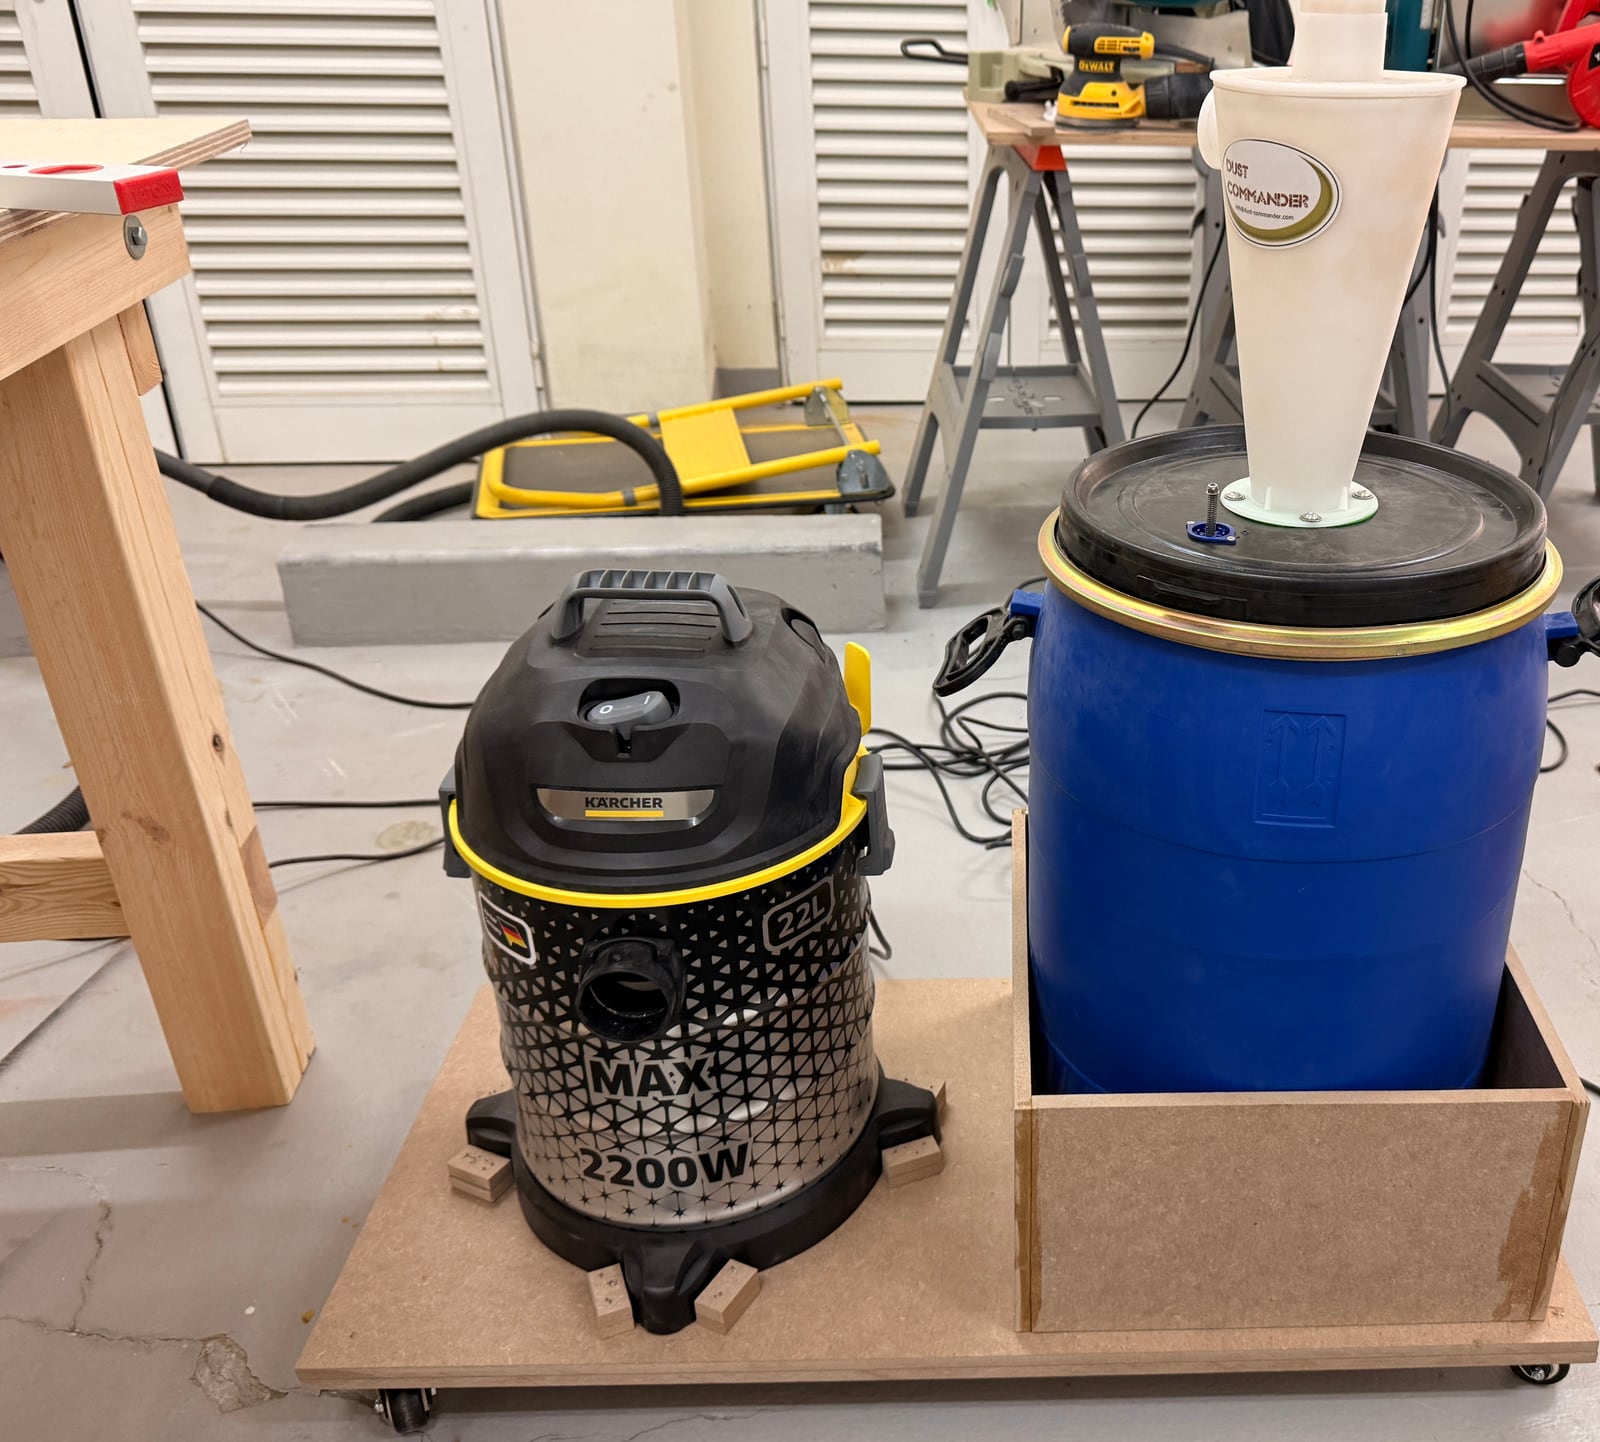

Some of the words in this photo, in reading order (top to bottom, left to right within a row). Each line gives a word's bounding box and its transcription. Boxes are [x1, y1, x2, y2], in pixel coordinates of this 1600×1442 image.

[1226, 158, 1249, 179] DUST
[1227, 181, 1310, 208] COMMANDER
[584, 796, 664, 809] KÄRCHER
[777, 895, 826, 940] 22L
[589, 1056, 713, 1098] MAX
[579, 1141, 750, 1189] 2200W
